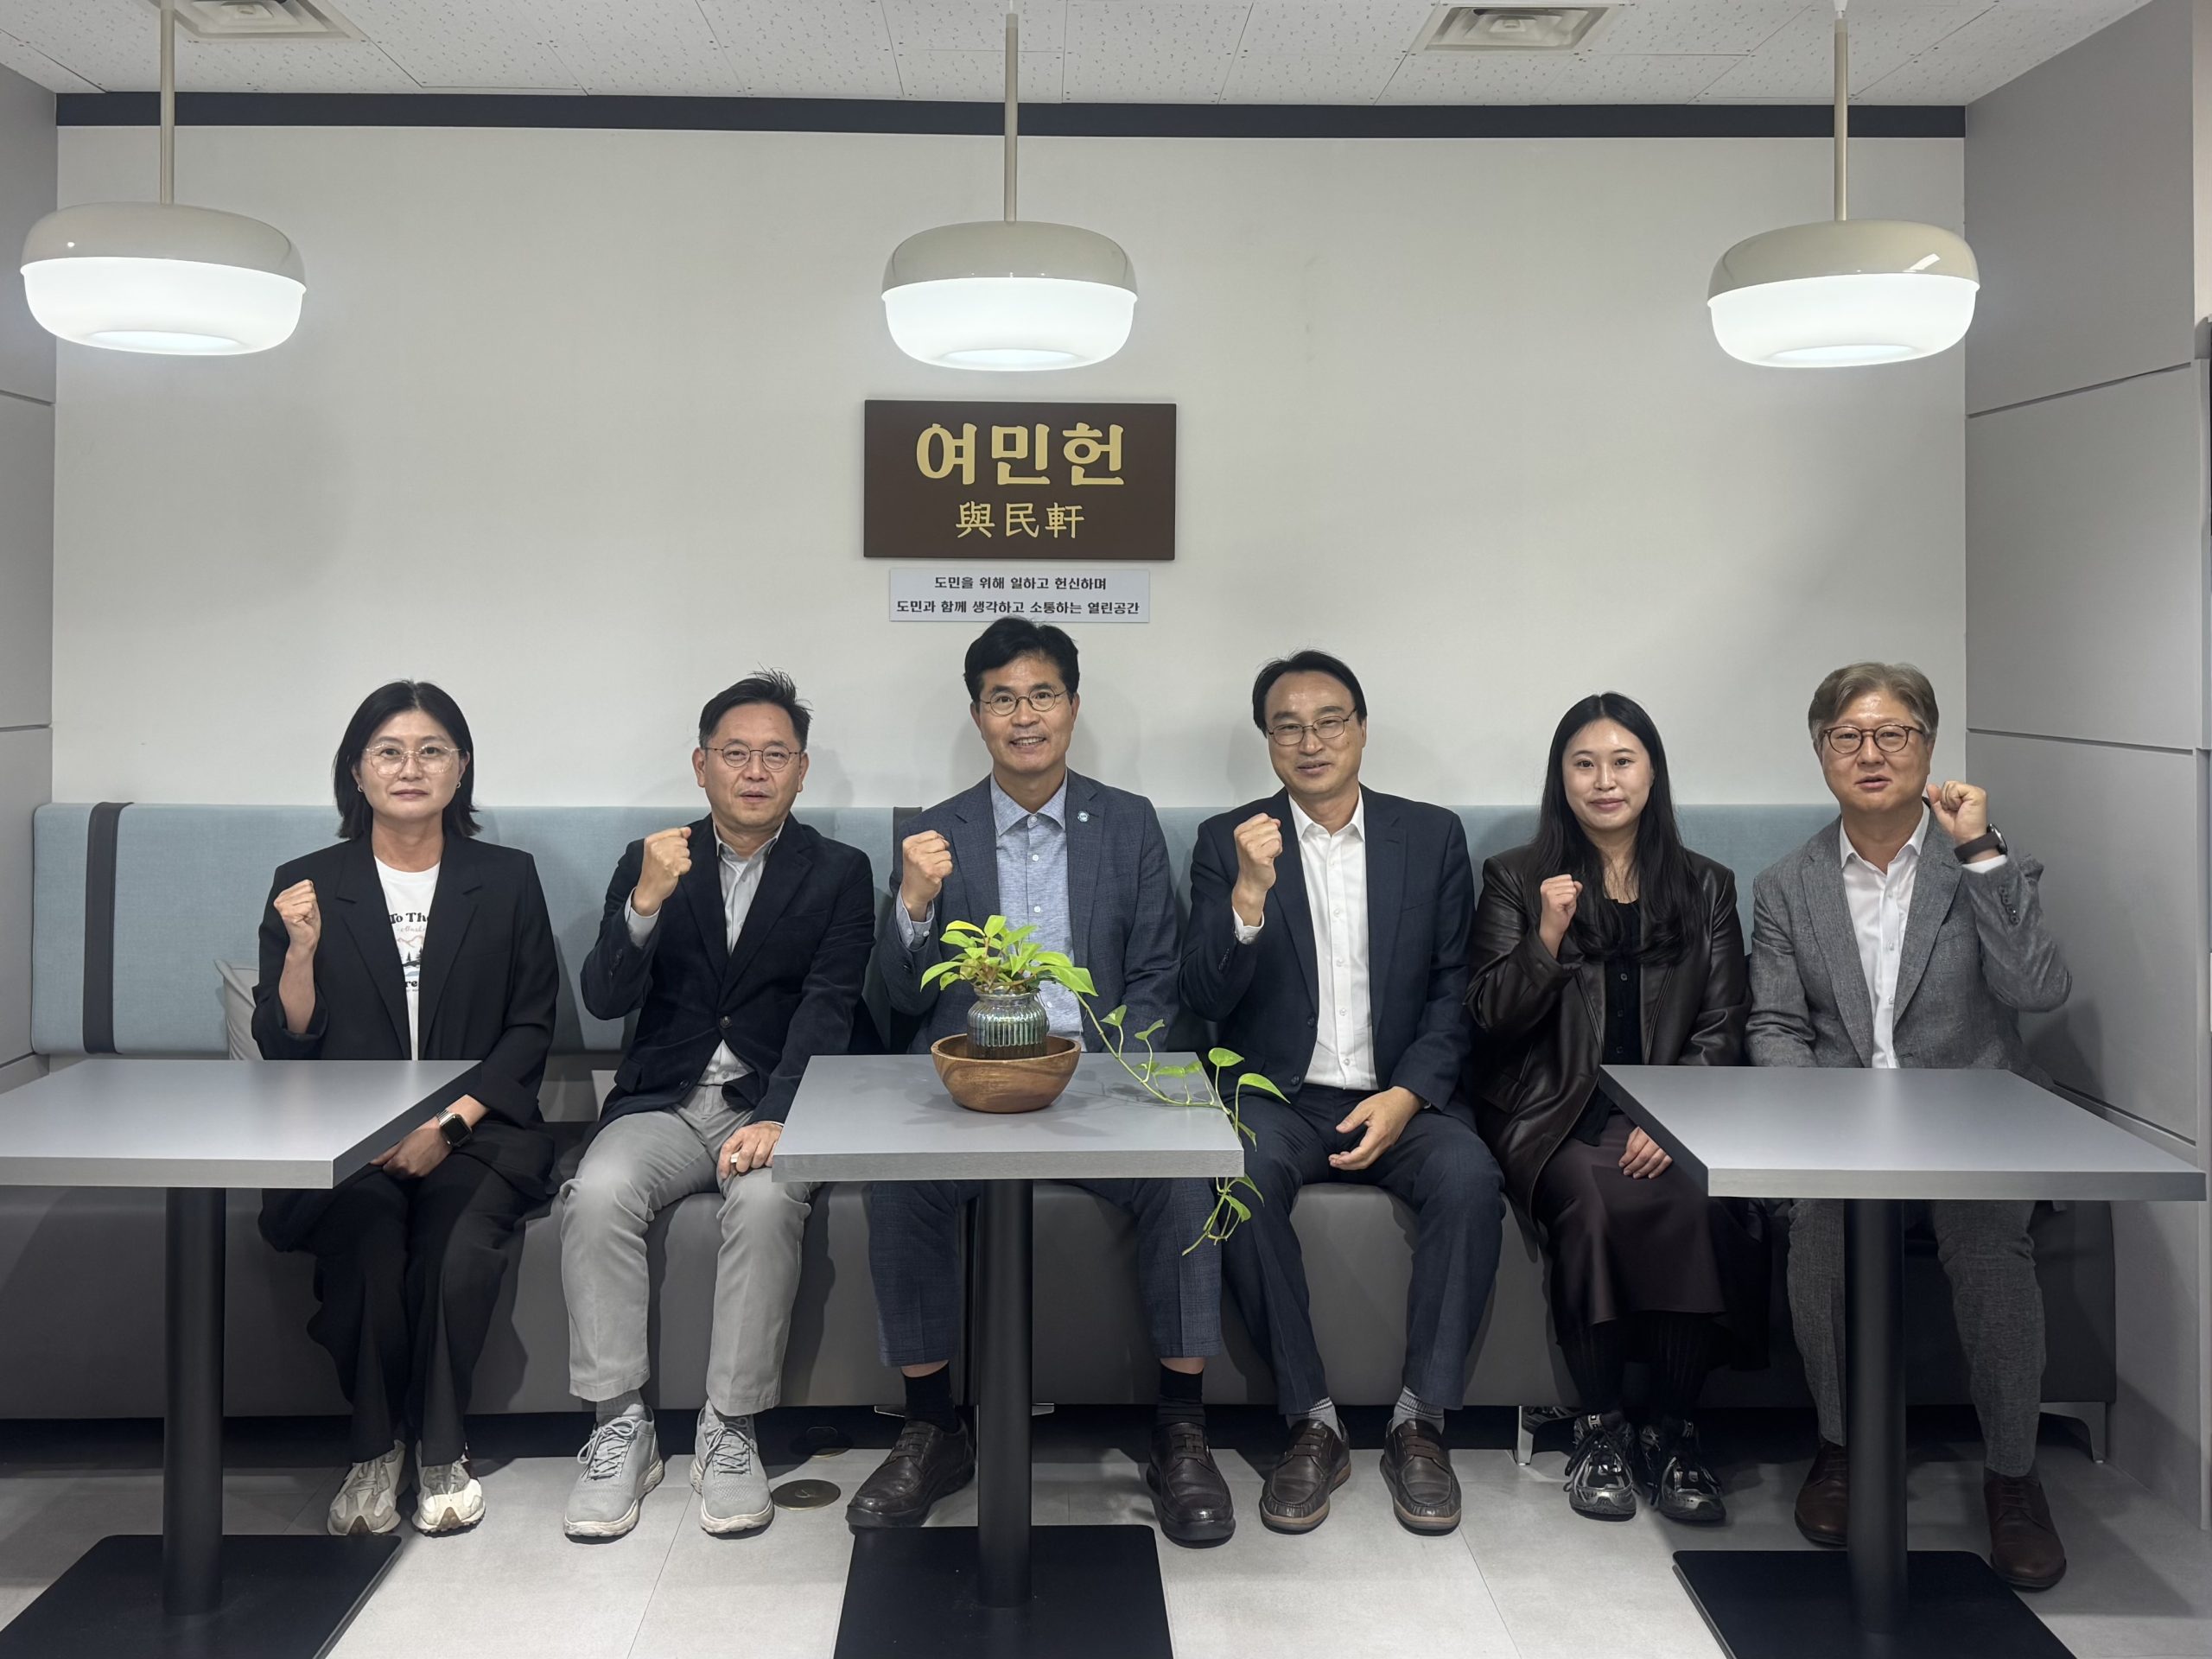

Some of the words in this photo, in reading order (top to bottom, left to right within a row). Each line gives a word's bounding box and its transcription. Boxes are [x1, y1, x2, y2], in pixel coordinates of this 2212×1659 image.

[916, 423, 1124, 486] 여민헌
[956, 501, 1084, 538] 與民軒
[935, 576, 974, 589] 도민을
[980, 576, 1005, 589] 위해
[1010, 577, 1049, 589] 일하고
[1055, 577, 1107, 590] 헌신하며
[897, 601, 936, 613] 도민과
[941, 601, 967, 613] 함께
[972, 601, 1025, 613] 생각하고
[1030, 601, 1082, 613] 소통하는
[1087, 601, 1140, 614] 열린공간
